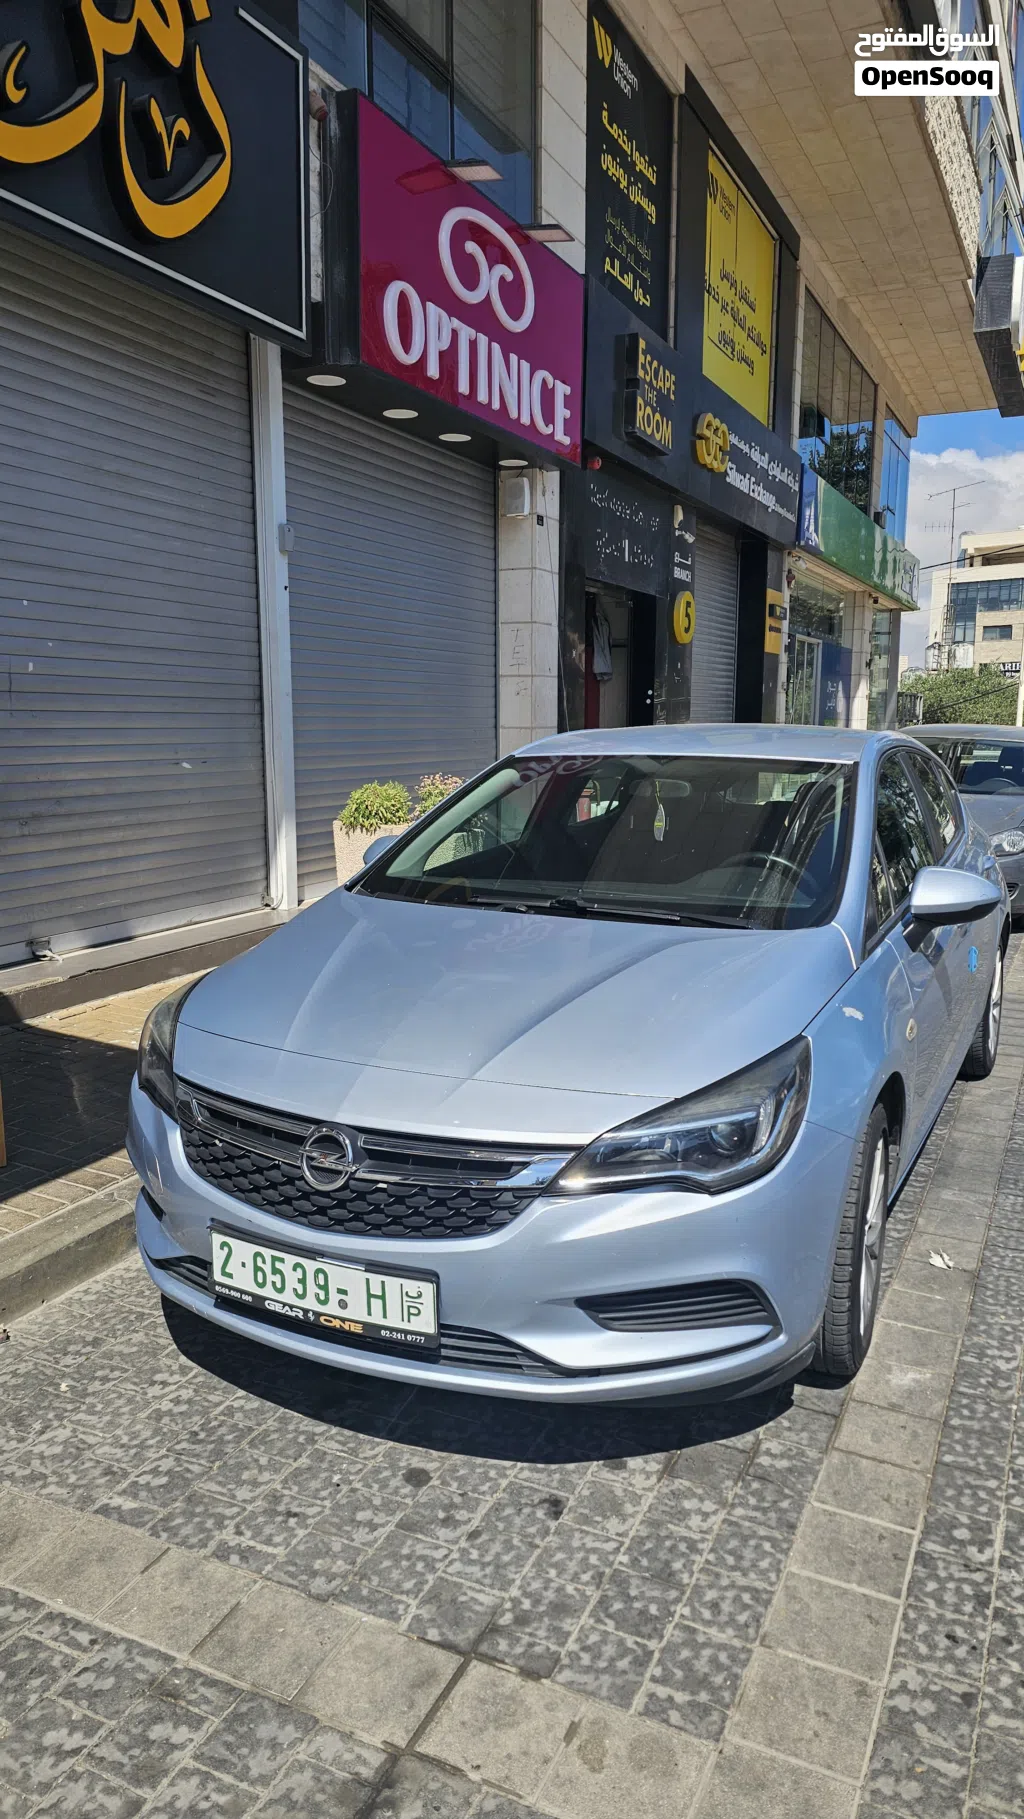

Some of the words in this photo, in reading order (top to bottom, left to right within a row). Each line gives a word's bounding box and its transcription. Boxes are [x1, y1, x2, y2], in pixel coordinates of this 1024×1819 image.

[613, 44, 638, 91] Western
[613, 62, 632, 99] Union
[602, 101, 632, 162] بخدمة
[601, 144, 628, 194] يونيون
[632, 140, 657, 185] تمتعوا
[629, 176, 657, 224] ويسترن
[604, 256, 634, 292] العالم
[633, 279, 651, 307] حول
[383, 279, 571, 447] OPTINICE
[638, 337, 676, 401] ESCAPE
[644, 384, 657, 407] THE
[636, 395, 672, 450] ROOM
[726, 461, 750, 495] Silwadi
[749, 476, 776, 513] Exchange
[674, 566, 692, 583] BRANCH
[684, 601, 692, 635] 5
[264, 1299, 304, 1320] GEAR
[319, 1315, 364, 1334] ONE
[407, 1304, 422, 1324] P
[406, 1335, 425, 1344] 0777
